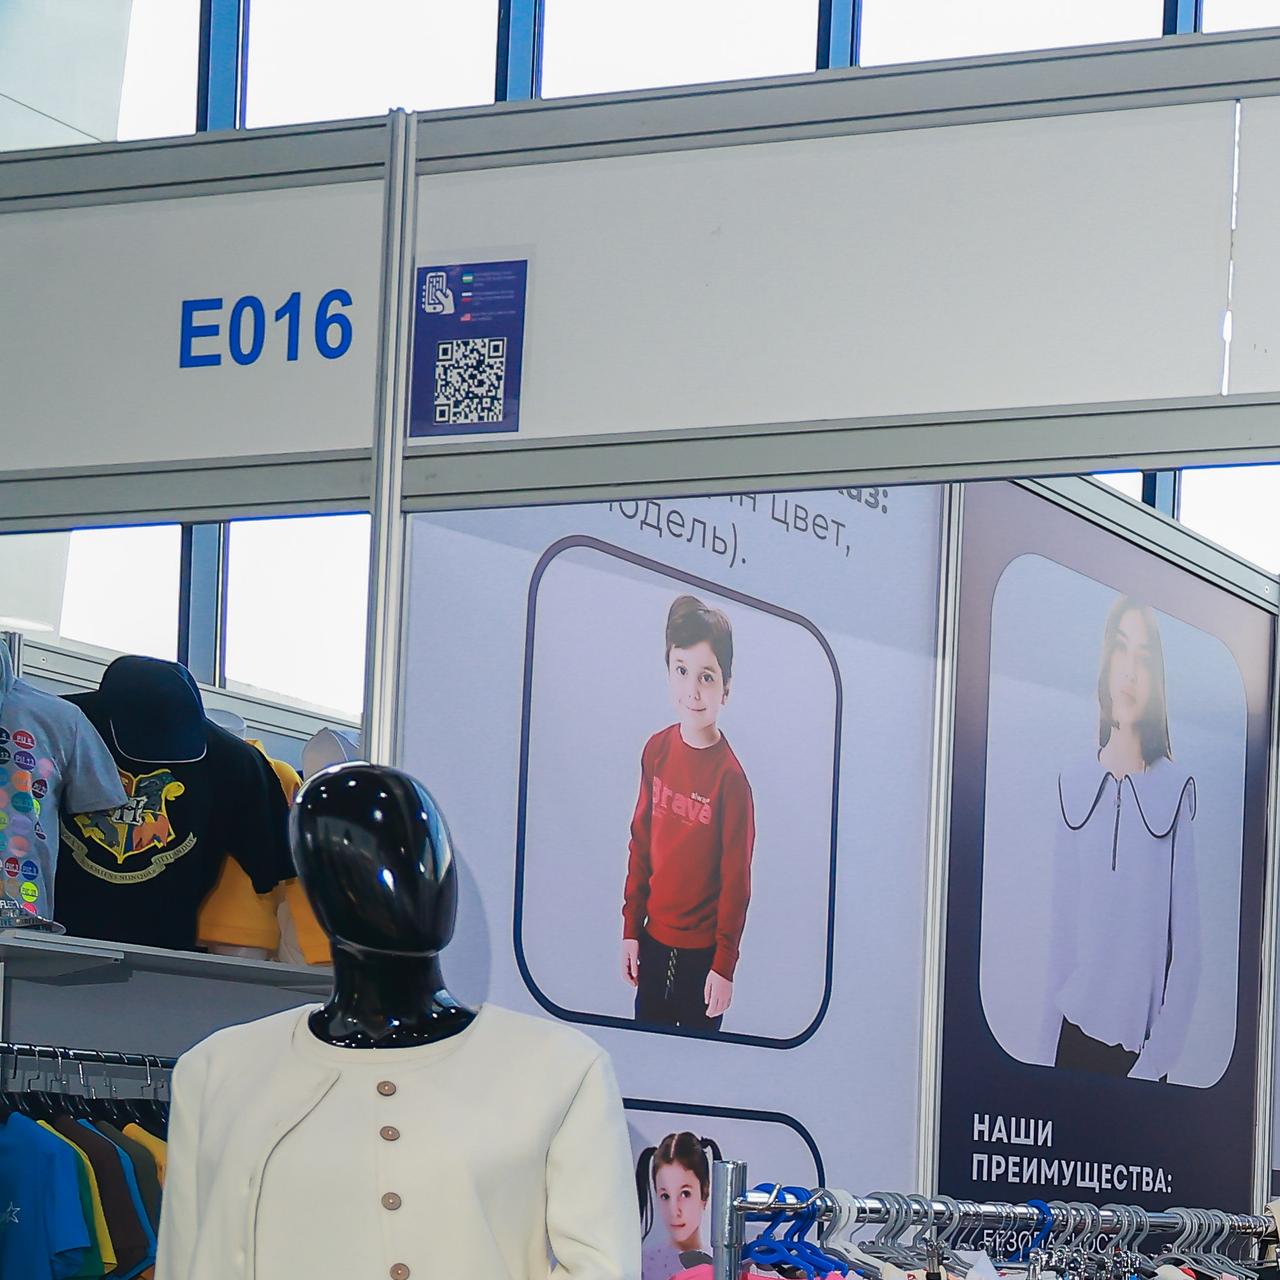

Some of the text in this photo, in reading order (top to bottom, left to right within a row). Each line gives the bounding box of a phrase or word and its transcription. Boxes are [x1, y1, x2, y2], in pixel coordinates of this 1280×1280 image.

[178, 288, 354, 369] E016
[609, 499, 746, 568] одель).
[973, 1113, 1052, 1147] НАШИ
[972, 1153, 1173, 1193] ПРЕИМУЩЕСТВА:
